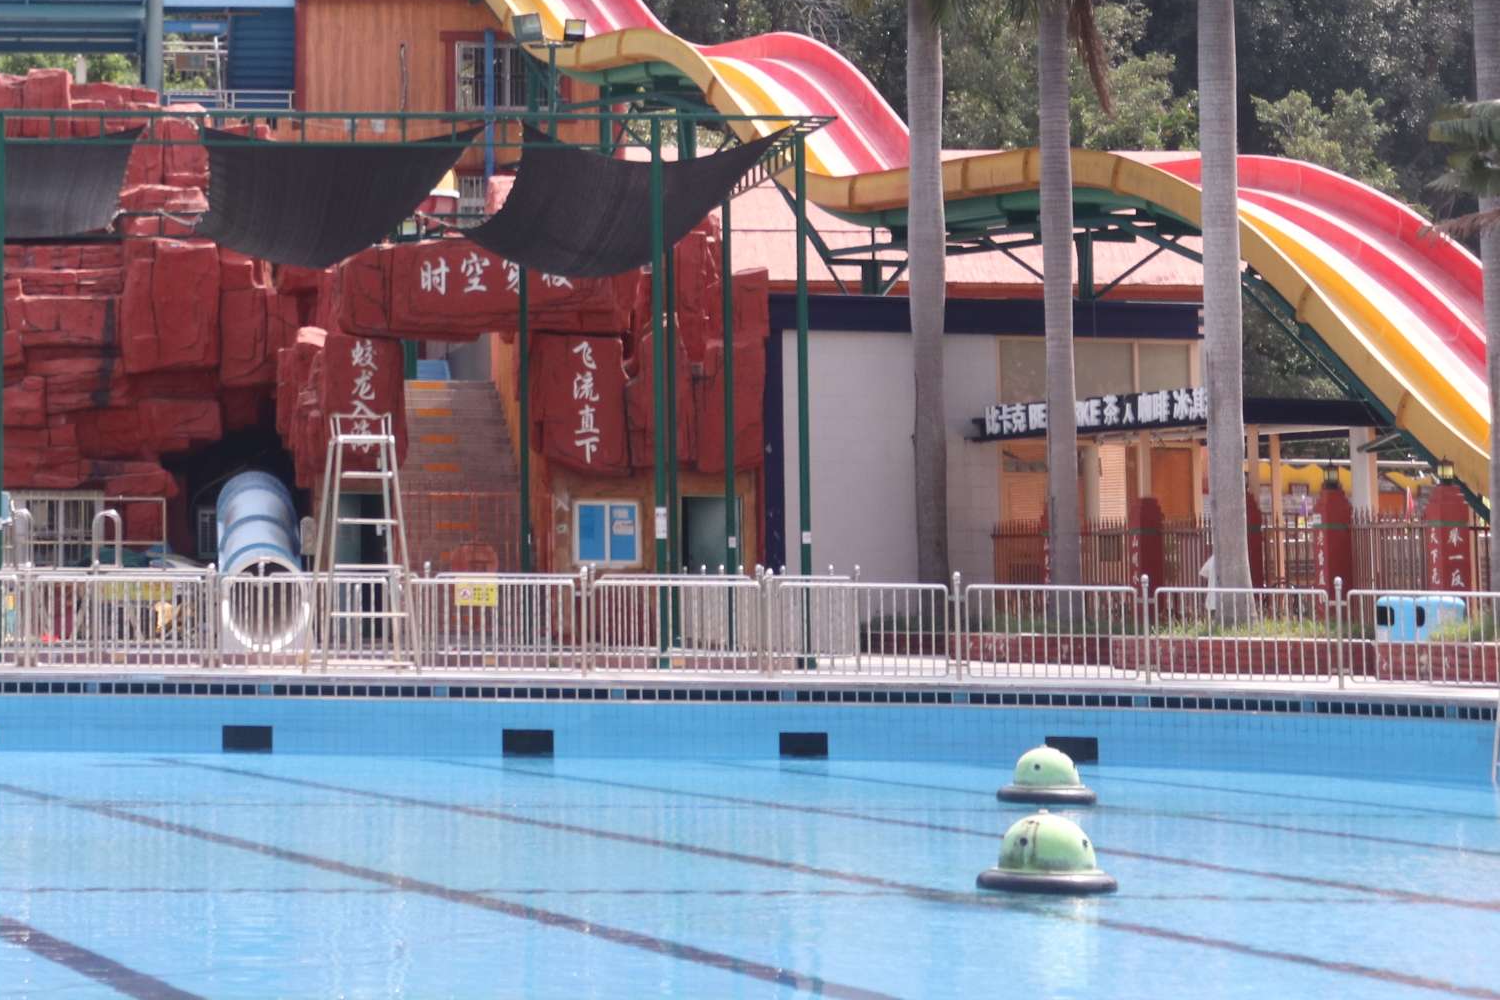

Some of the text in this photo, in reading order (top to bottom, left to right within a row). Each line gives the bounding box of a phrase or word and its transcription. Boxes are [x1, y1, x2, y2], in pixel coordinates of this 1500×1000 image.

[572, 341, 600, 464] 飞流直下
[985, 402, 1028, 436] 比卡克
[1138, 389, 1171, 424] 咖啡
[1173, 386, 1209, 421] 冰淇
